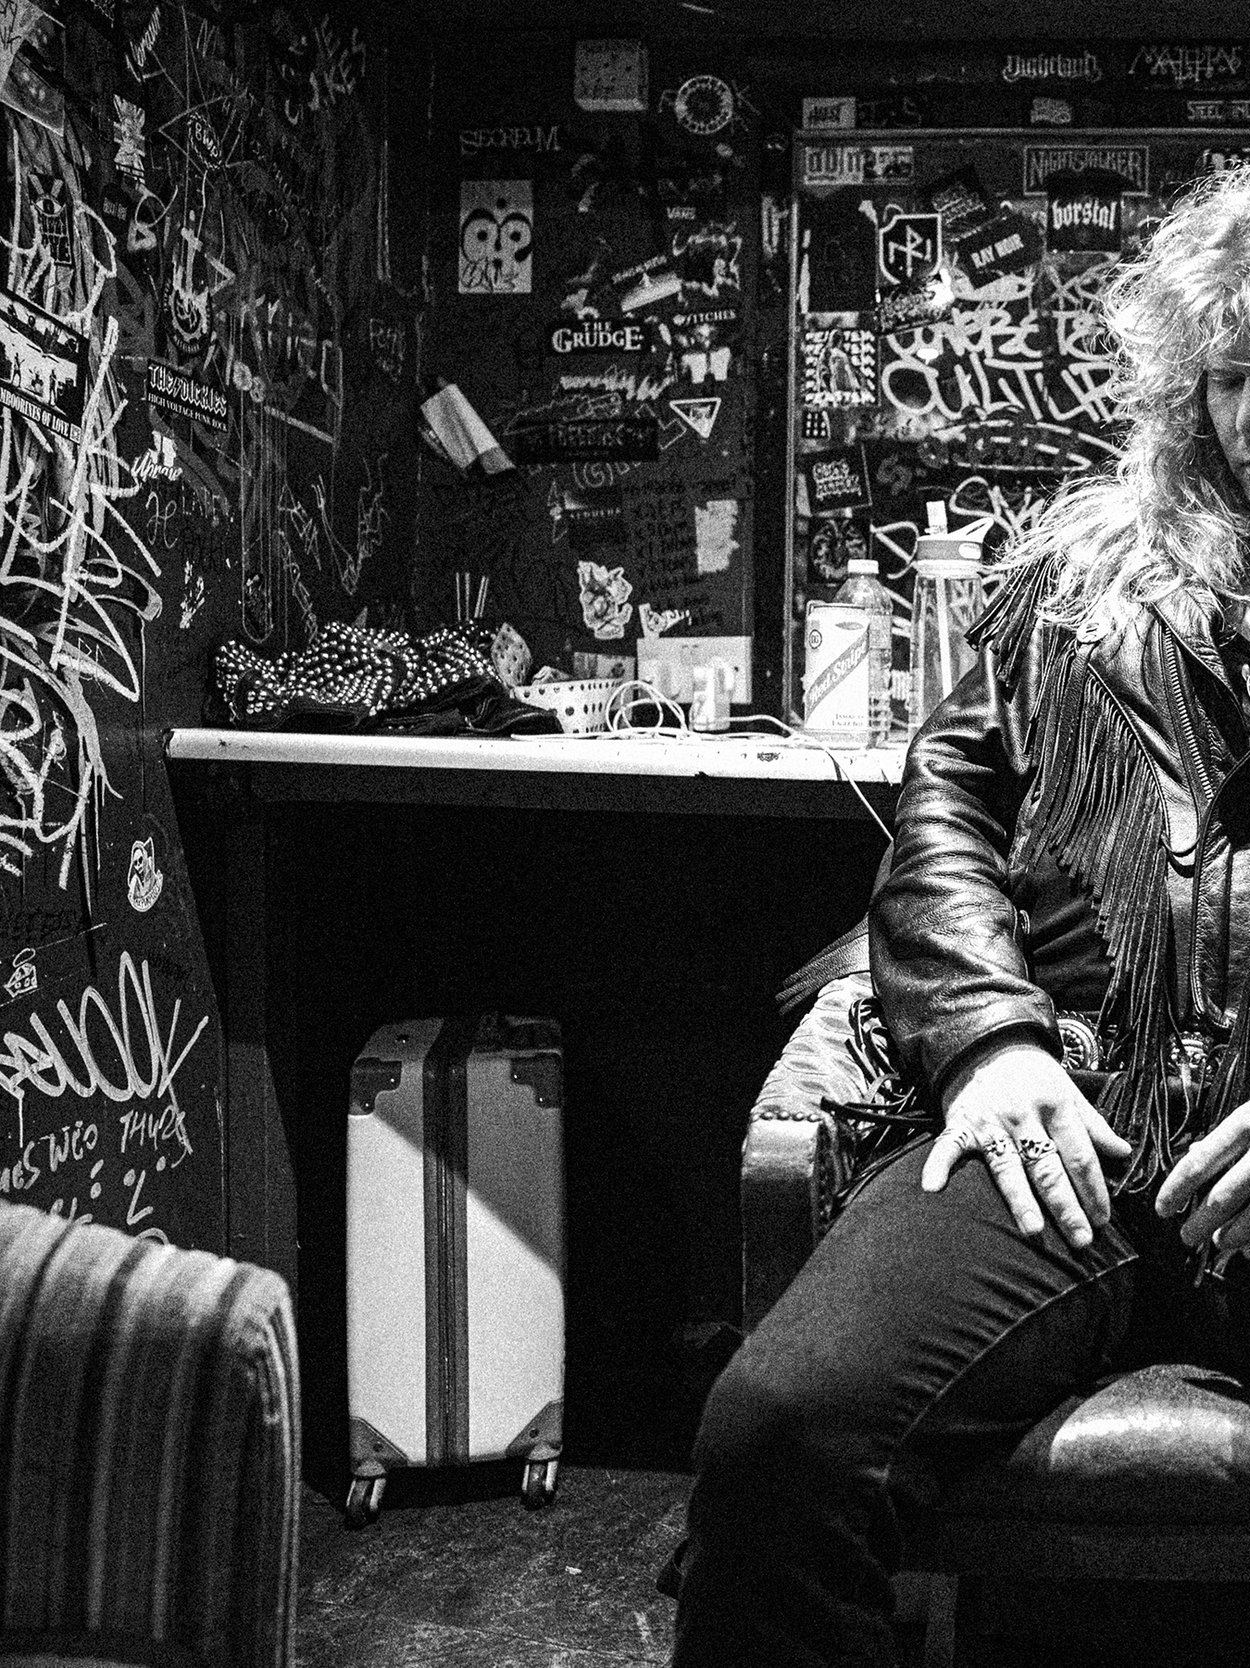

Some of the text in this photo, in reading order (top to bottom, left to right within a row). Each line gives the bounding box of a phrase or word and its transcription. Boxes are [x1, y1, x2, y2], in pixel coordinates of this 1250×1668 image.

[1052, 198, 1117, 230] borstal
[551, 327, 645, 353] GRUDGE
[41, 412, 52, 428] OF
[51, 415, 72, 437] LOVE
[147, 392, 228, 432] HIGH VOLTAGE PUNK ROCK
